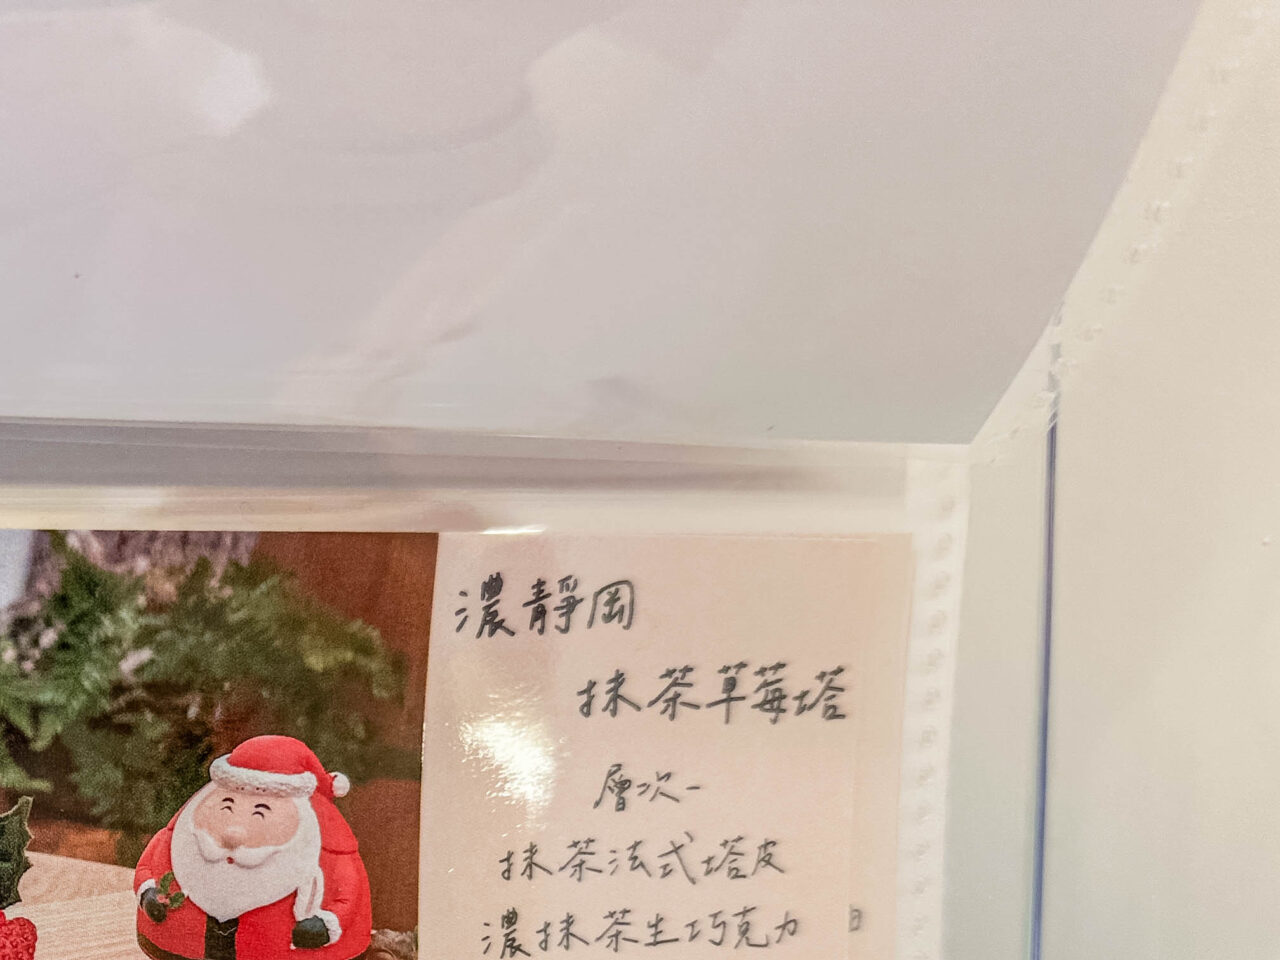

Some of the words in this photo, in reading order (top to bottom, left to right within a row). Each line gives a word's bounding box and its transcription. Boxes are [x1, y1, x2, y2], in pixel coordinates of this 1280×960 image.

[454, 572, 636, 639] 濃靜岡
[576, 661, 847, 724] 抹茶草莓塔
[498, 831, 786, 886] 抹茶法式塔皮
[481, 906, 799, 960] 濃抹茶生巧克力
